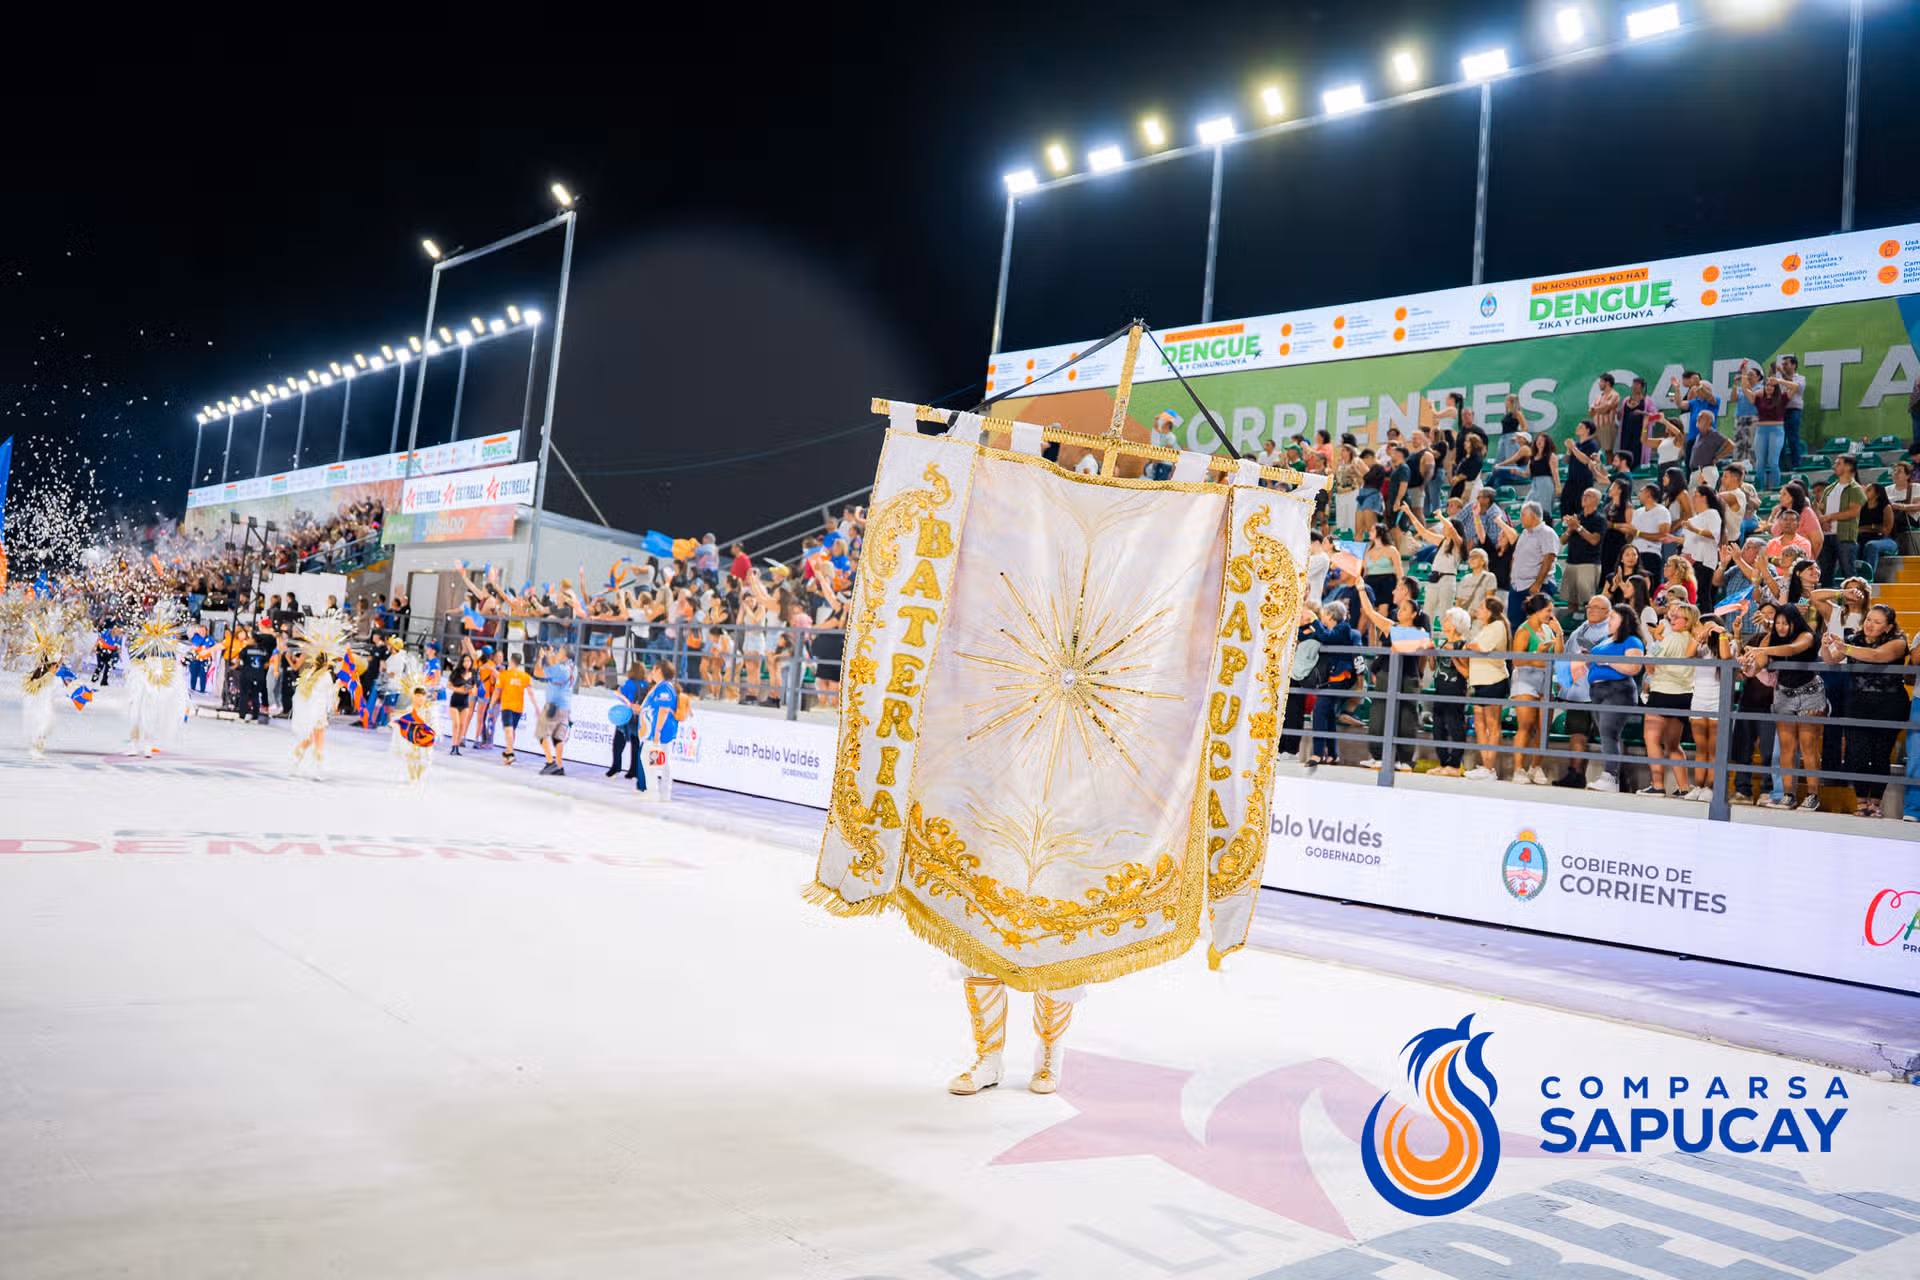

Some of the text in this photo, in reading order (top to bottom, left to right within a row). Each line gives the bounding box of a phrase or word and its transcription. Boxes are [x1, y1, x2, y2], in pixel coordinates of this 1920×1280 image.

[1534, 271, 1647, 293] SIN MOSQUITOS NO HAY
[1529, 281, 1672, 321] DENGUE
[1538, 309, 1654, 330] ZIKA Y CHIKUNGUNYA
[1162, 335, 1260, 365] DENGUE
[1158, 345, 1920, 456] ORRIENTES CAPTA
[416, 490, 441, 504] ESTRELLA
[455, 484, 484, 500] ESTRELLA
[500, 478, 530, 496] ESTRELLA
[867, 516, 954, 830] BATERIA
[574, 729, 613, 745] CORRIENTE
[725, 740, 820, 768] Juan Pablo Valdés
[1270, 813, 1383, 849] blo Valdés
[1305, 845, 1381, 866] GOBERNADOR
[1561, 855, 1693, 885] GOBIERNO DE
[1559, 874, 1727, 915] CORRIENTES
